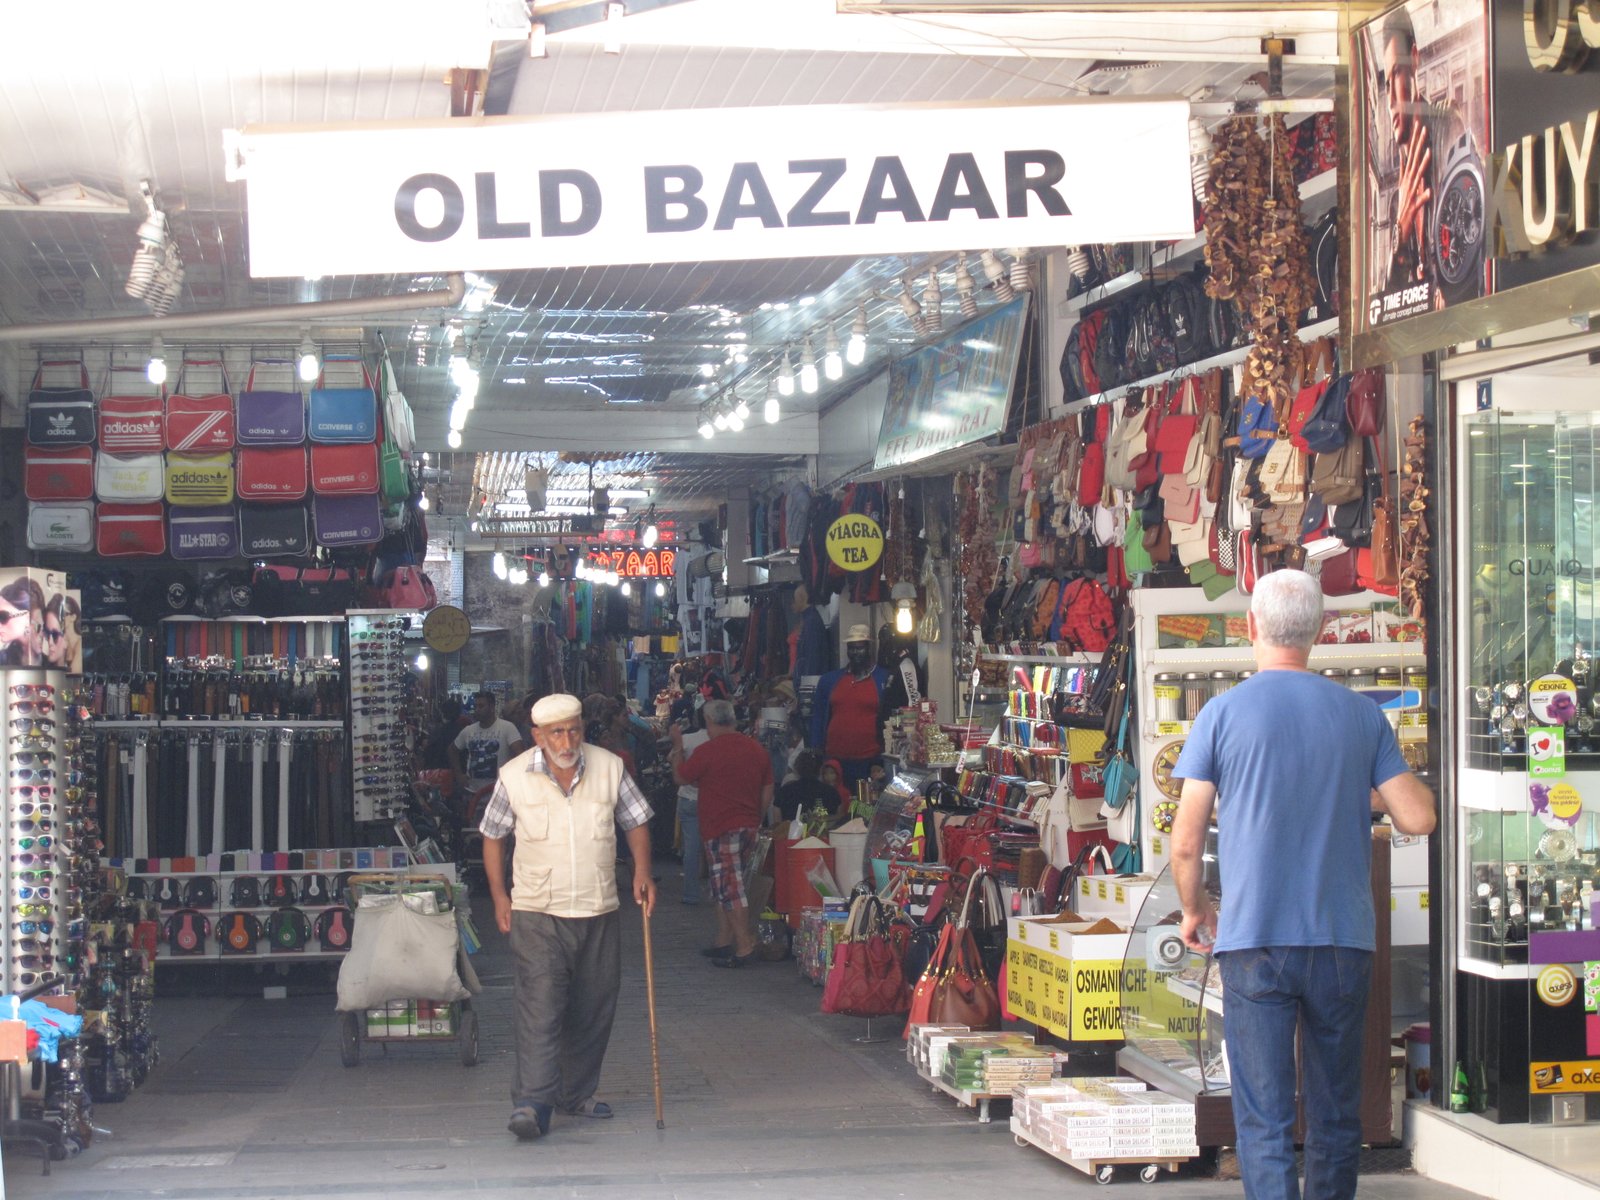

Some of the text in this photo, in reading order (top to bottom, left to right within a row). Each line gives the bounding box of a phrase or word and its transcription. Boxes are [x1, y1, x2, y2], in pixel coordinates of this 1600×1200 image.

[397, 149, 1073, 241] OLD BAZAAR
[1383, 283, 1429, 311] TIME FORCE
[1481, 387, 1488, 405] 4
[47, 427, 76, 436] adidas
[104, 422, 143, 433] adidas
[318, 423, 353, 431] CONVERSE
[171, 472, 210, 484] adidas
[320, 475, 355, 484] CONVERSE
[46, 532, 74, 540] LACOSTE
[179, 533, 217, 547] ALL STAR
[323, 530, 358, 539] CONVERSE
[252, 538, 280, 549] adidas
[842, 547, 869, 563] TEA
[1548, 981, 1573, 993] axess
